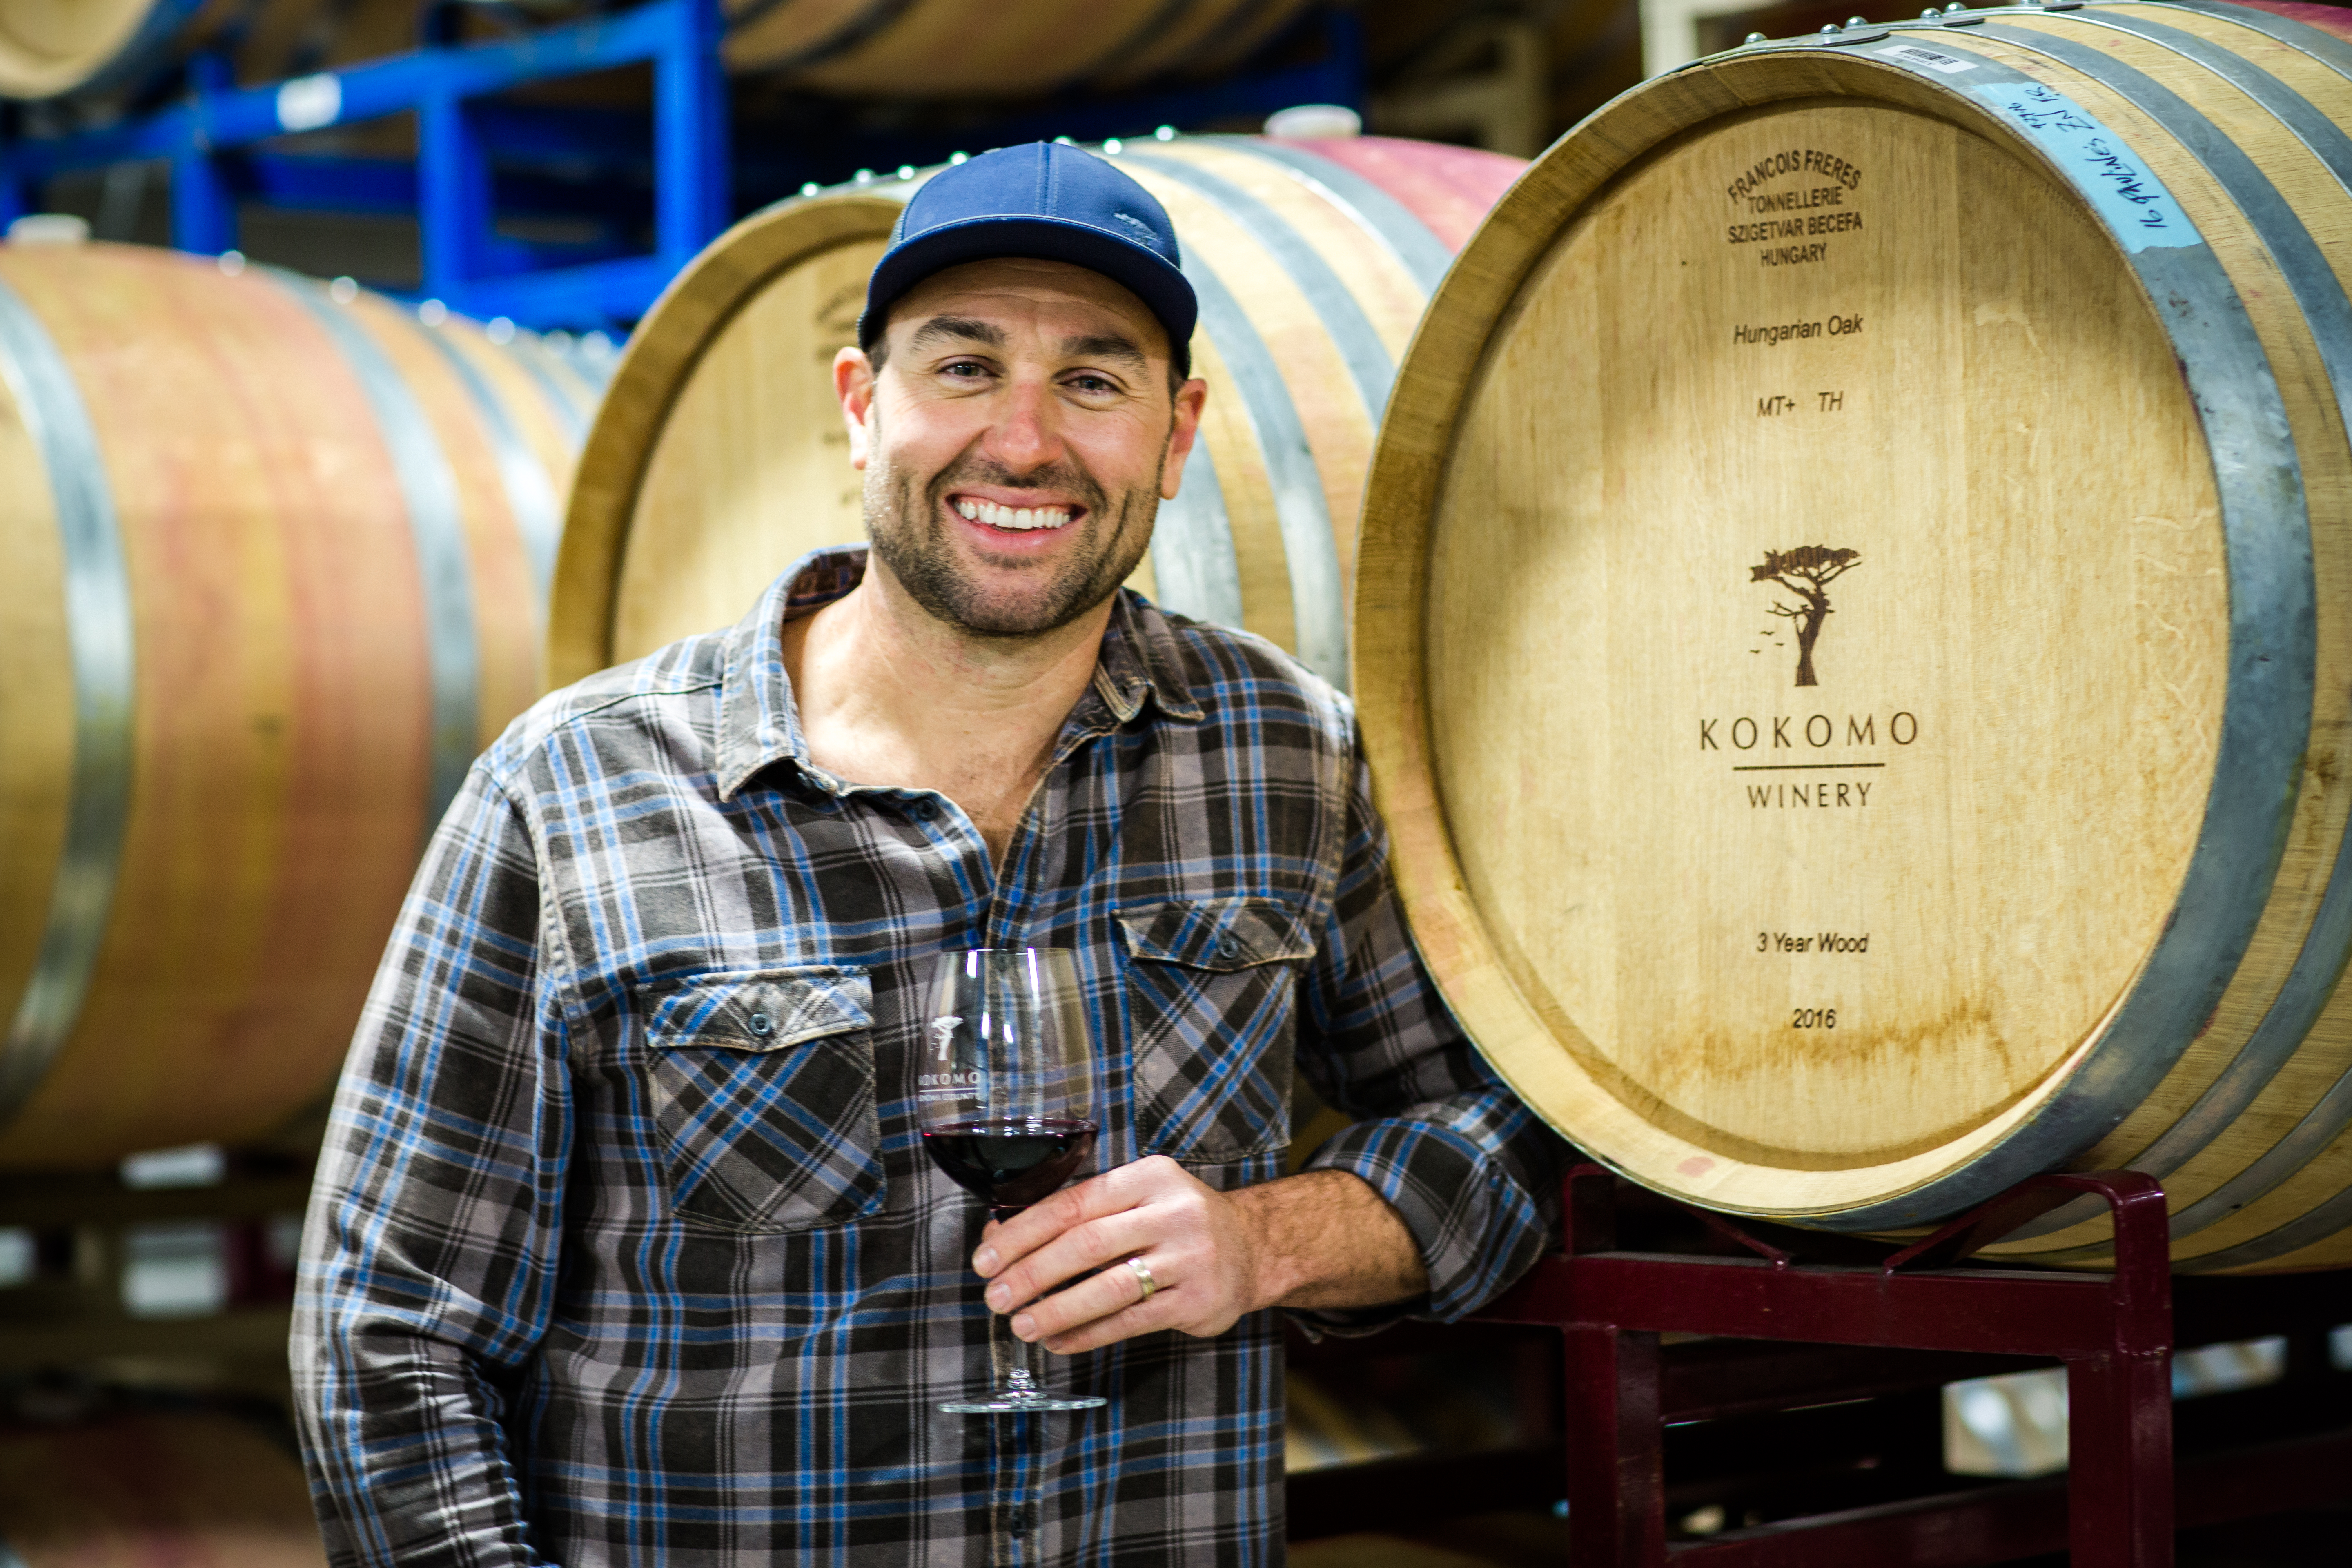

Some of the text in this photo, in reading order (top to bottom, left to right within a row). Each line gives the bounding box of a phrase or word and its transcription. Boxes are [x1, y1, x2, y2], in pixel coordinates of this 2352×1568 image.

[1728, 149, 1862, 204] FRANCOIS FRERES
[1747, 186, 1843, 214] TONNELLERIE
[1728, 212, 1863, 245] SZIGETVAR BECEFA
[2139, 209, 2168, 228] 16
[1760, 243, 1827, 267] HUNGARY
[1734, 313, 1863, 346] Hungarian Oak
[1757, 390, 1844, 417] MT+ TH
[1700, 711, 1918, 751] KOKOMO
[1747, 782, 1872, 808] WINERY
[1757, 932, 1870, 953] 3 Year Wood
[1793, 1008, 1837, 1029] 2016
